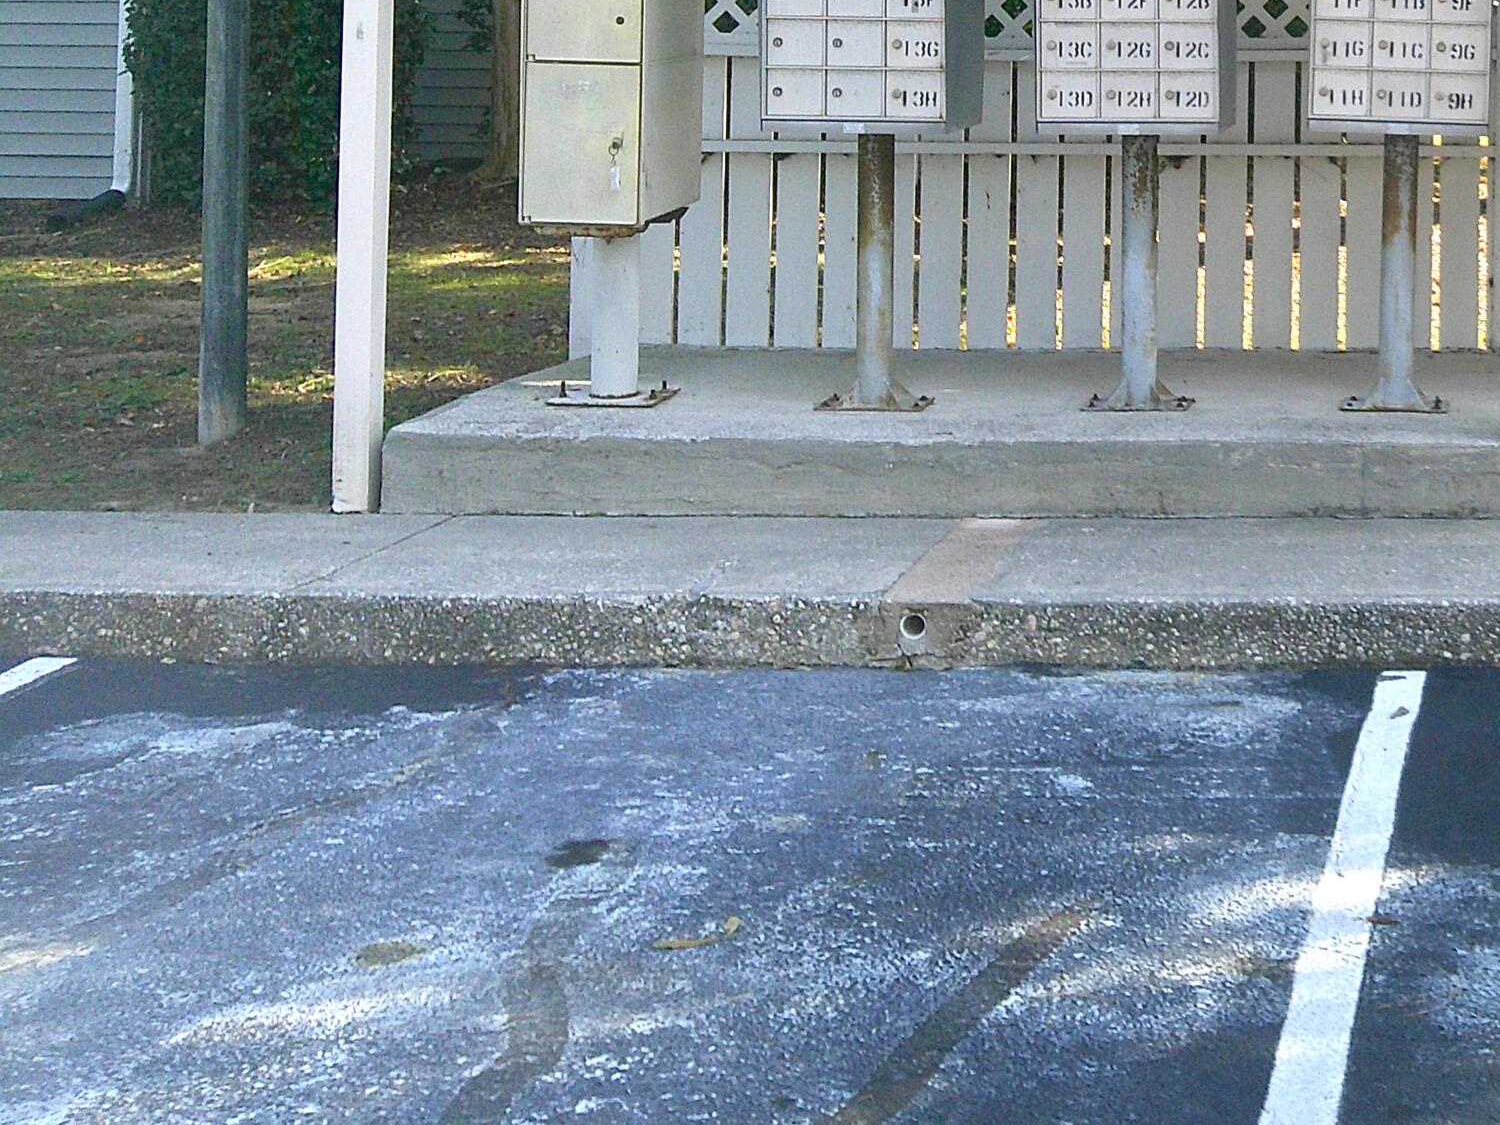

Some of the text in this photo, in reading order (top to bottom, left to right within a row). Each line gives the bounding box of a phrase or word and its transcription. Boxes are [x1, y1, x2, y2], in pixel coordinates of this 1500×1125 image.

[906, 41, 938, 57] 13G
[1059, 42, 1091, 57] 13C
[1118, 42, 1150, 58] 12G
[1176, 42, 1208, 58] 12C
[1333, 41, 1363, 57] 11G
[1390, 42, 1422, 58] 11C
[1451, 44, 1475, 59] 9G
[903, 91, 936, 107] 13H
[1060, 91, 1092, 106] 13D
[1118, 91, 1150, 107] 12H
[1176, 91, 1209, 107] 12D
[1330, 89, 1363, 105] 11H
[1389, 91, 1421, 107] 11D
[1449, 94, 1472, 109] 9H
